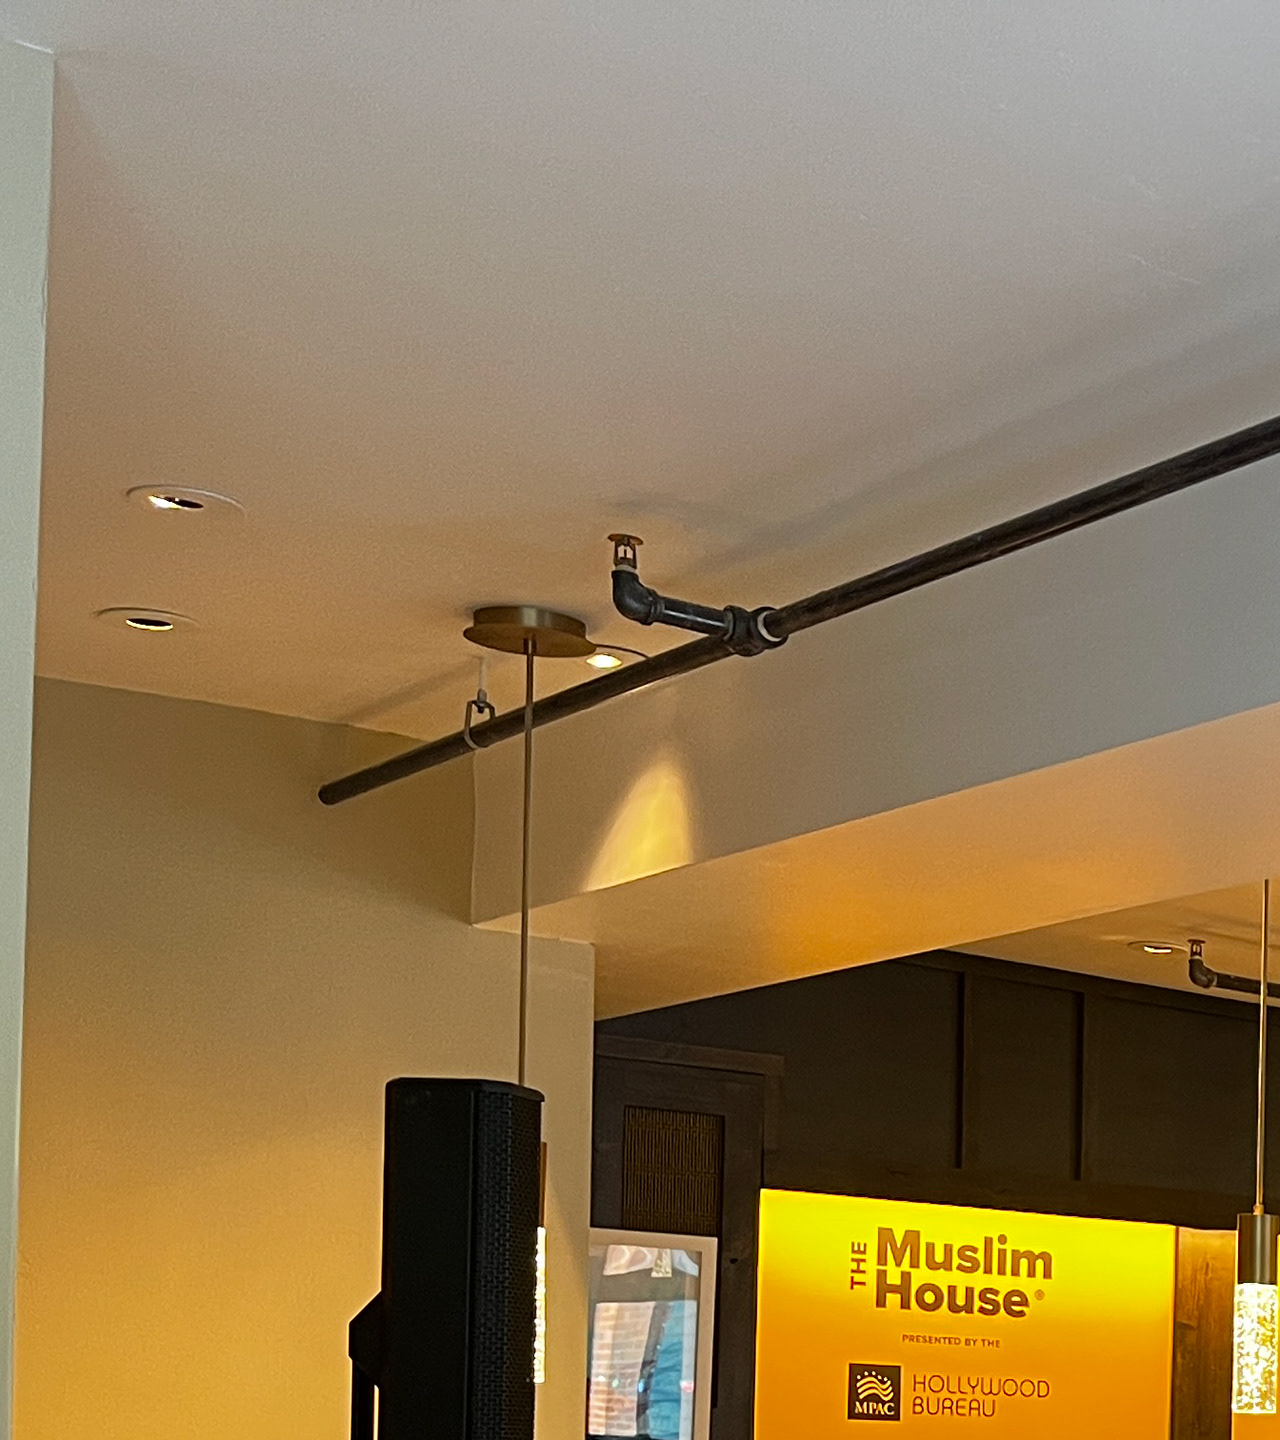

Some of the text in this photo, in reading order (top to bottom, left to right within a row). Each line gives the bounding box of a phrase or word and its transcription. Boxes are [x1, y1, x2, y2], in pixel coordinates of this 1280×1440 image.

[876, 1226, 1053, 1280] Muslim
[850, 1241, 867, 1290] THE
[902, 1334, 1000, 1348] PRESENTED BY THE
[912, 1374, 1050, 1398] HOLLYWOOD
[854, 1401, 895, 1416] MPAC
[912, 1396, 996, 1418] BUREAU
